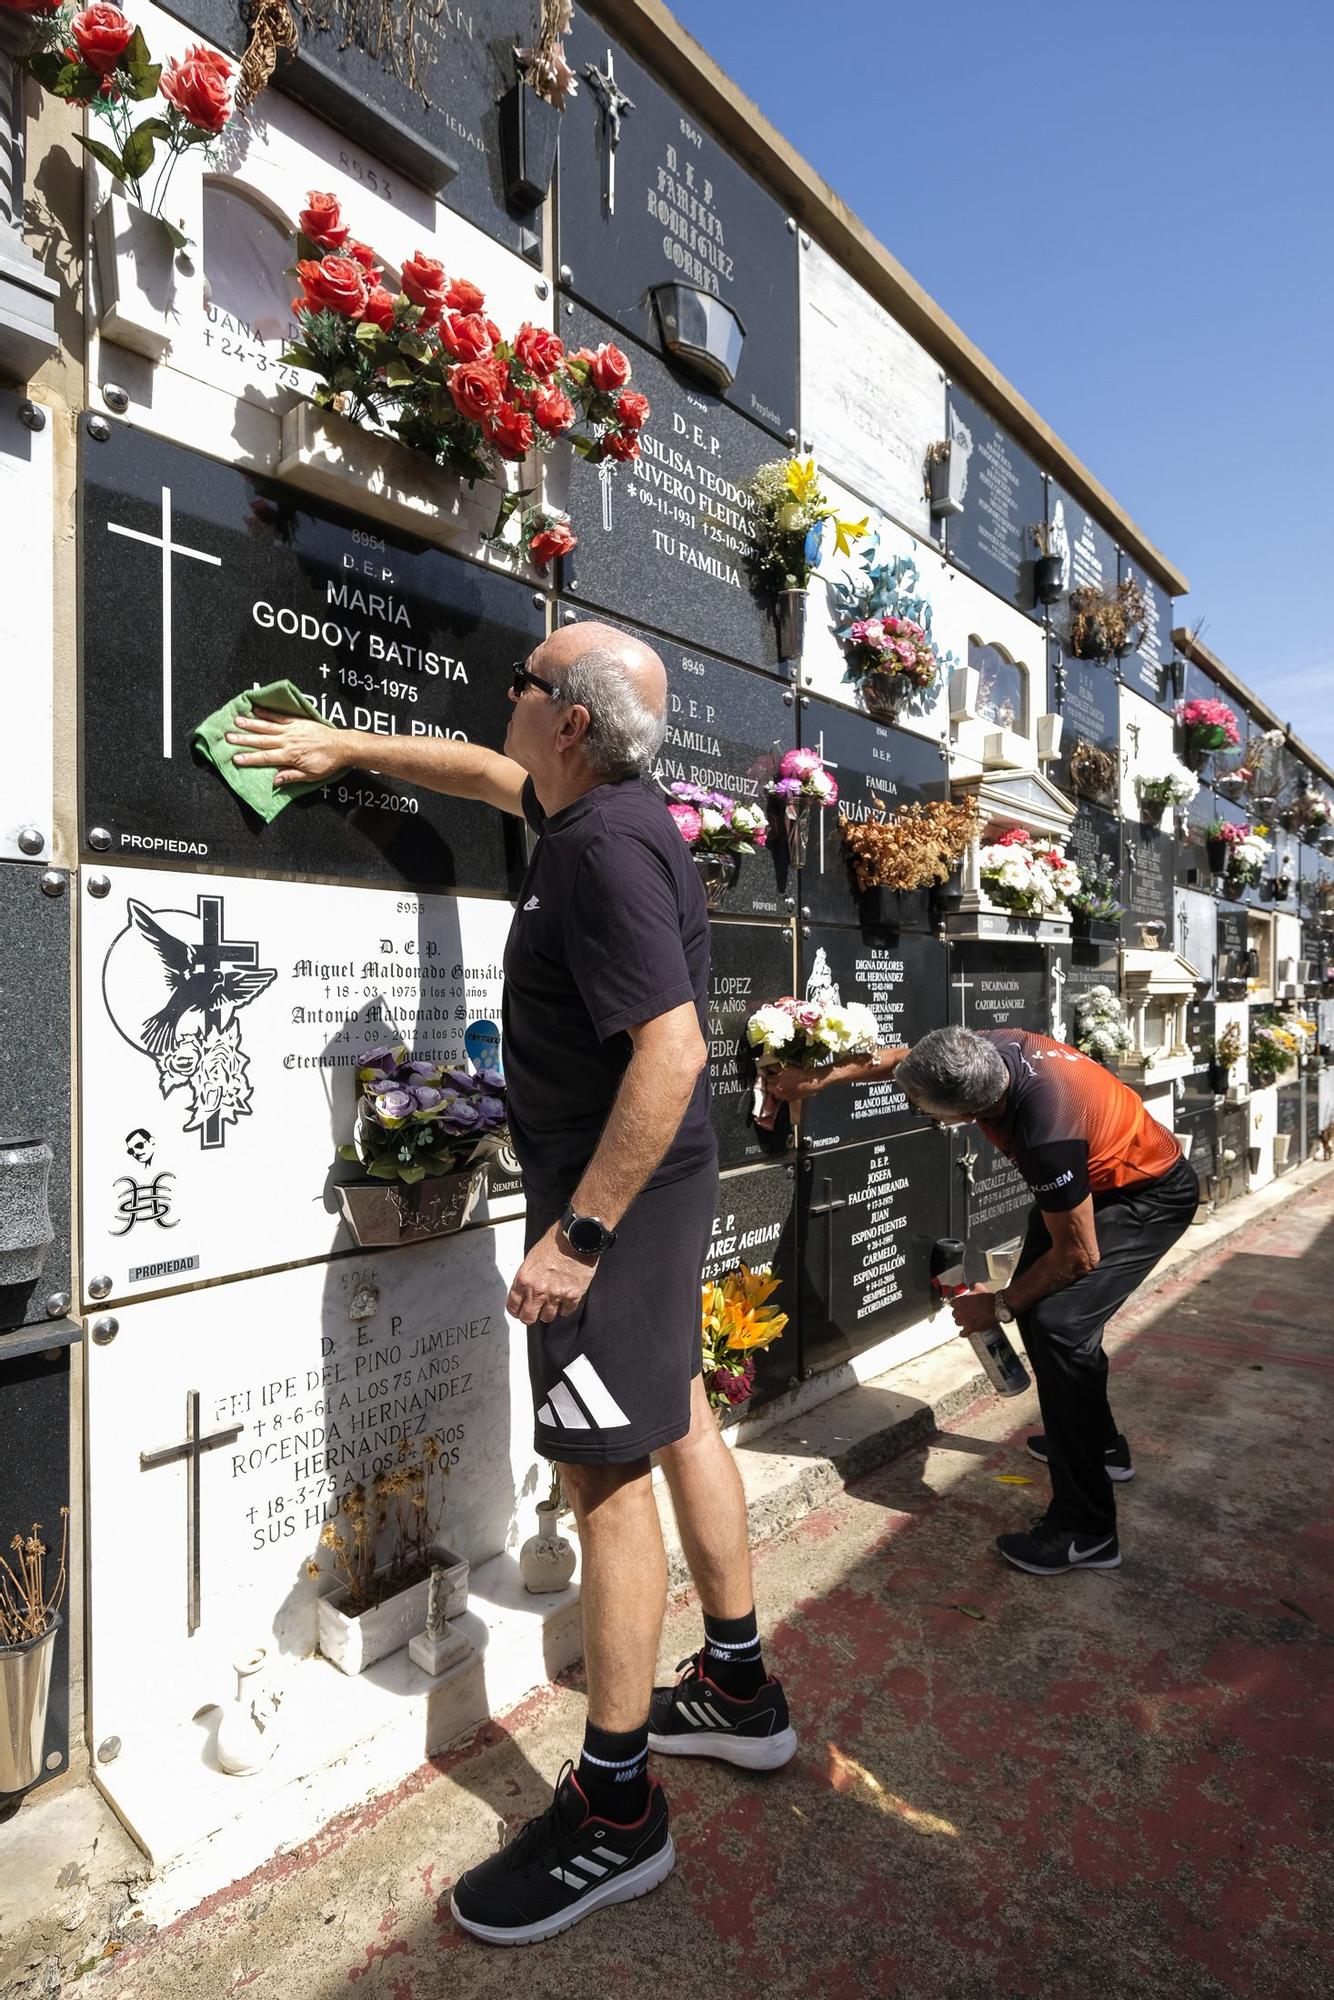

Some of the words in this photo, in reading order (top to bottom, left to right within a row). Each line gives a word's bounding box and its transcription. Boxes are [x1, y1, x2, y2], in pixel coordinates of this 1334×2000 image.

[657, 166, 724, 246] FAMILIA
[648, 188, 734, 281] RODRIGUEZ
[221, 338, 299, 387] 24-3-75
[633, 458, 695, 505] RIVERO
[699, 492, 756, 539] FLEITAS
[640, 489, 695, 529] 09-11-1931
[351, 528, 385, 553] 8954
[653, 529, 675, 556] TU
[679, 543, 741, 588] FAMILIA
[327, 580, 411, 628] MARÍA
[252, 601, 360, 651] GODOY
[370, 635, 469, 684] BATISTA
[682, 657, 705, 676] 8949
[338, 668, 418, 703] 18-3-1975
[664, 725, 722, 757] FAMILIA
[690, 765, 759, 798] RODRIGUEZ
[866, 775, 898, 796] FAMILIA
[338, 786, 418, 814] 9-12-2020
[121, 833, 208, 855] PROPIEDAD
[396, 902, 425, 914] 8955
[752, 901, 778, 912] PROPIEDAD
[291, 960, 355, 980] Miguel
[361, 961, 446, 979] Maldonado
[451, 964, 504, 980] Gonzále
[855, 960, 875, 970] DIGNA
[876, 960, 904, 971] DOLORES
[855, 972, 867, 982] GIL
[867, 970, 904, 982] HERNÁNDEZ
[430, 986, 446, 998] los
[449, 987, 463, 998] 40
[466, 987, 488, 998] años
[714, 977, 752, 995] LOPEZ
[981, 979, 1020, 992] ENCARNACIÓN
[721, 997, 746, 1013] AÑOS
[873, 992, 889, 1002] PINO
[975, 999, 1001, 1011] CAZORLA
[1002, 996, 1025, 1010] SÁNCHEZ
[291, 1006, 359, 1025] Antonio
[365, 1006, 449, 1025] Maldonado
[432, 1029, 447, 1040] los
[451, 1027, 464, 1039] 50
[885, 1033, 901, 1043] CRUZ
[710, 1064, 719, 1077] 81
[710, 1083, 716, 1097] Y
[855, 1096, 880, 1110] BLANCO
[881, 1092, 906, 1105] BLANCO
[869, 1083, 892, 1097] RAMÓN
[813, 1136, 840, 1148] PROPIEDAD
[492, 1180, 520, 1193] SIEMPRE
[867, 1168, 892, 1185] JOSEFA
[848, 1187, 877, 1205] FALCÓN
[877, 1178, 909, 1197] MIRANDA
[870, 1208, 890, 1224] JUAN
[738, 1222, 780, 1250] AGUIAR
[851, 1227, 877, 1246] ESPINO
[877, 1216, 907, 1234] FUENTES
[862, 1244, 897, 1267] CARMELO
[135, 1257, 194, 1279] PROPIEDAD
[853, 1267, 879, 1286] ESPINO
[879, 1254, 906, 1275] FALCÓN
[857, 1290, 903, 1319] RECORDAREMOS
[862, 1286, 887, 1305] SIEMPRE
[887, 1282, 898, 1295] LES
[306, 1363, 346, 1391] DEL
[354, 1345, 402, 1377] PINO
[410, 1316, 492, 1359] JIMENEZ
[273, 1400, 332, 1431] 8-6-61
[339, 1393, 351, 1410] A
[357, 1379, 389, 1404] LOS
[393, 1371, 412, 1392] 75
[417, 1355, 460, 1384] AÑOS
[231, 1423, 342, 1478] ROCENDA
[351, 1372, 473, 1433] HERNANDEZ
[294, 1413, 427, 1482] HERNANDEZ
[267, 1475, 337, 1519] 18-3-75
[343, 1470, 356, 1488] A
[361, 1454, 394, 1479] LOS
[434, 1423, 465, 1446] ÑOS
[253, 1516, 297, 1551] SUS
